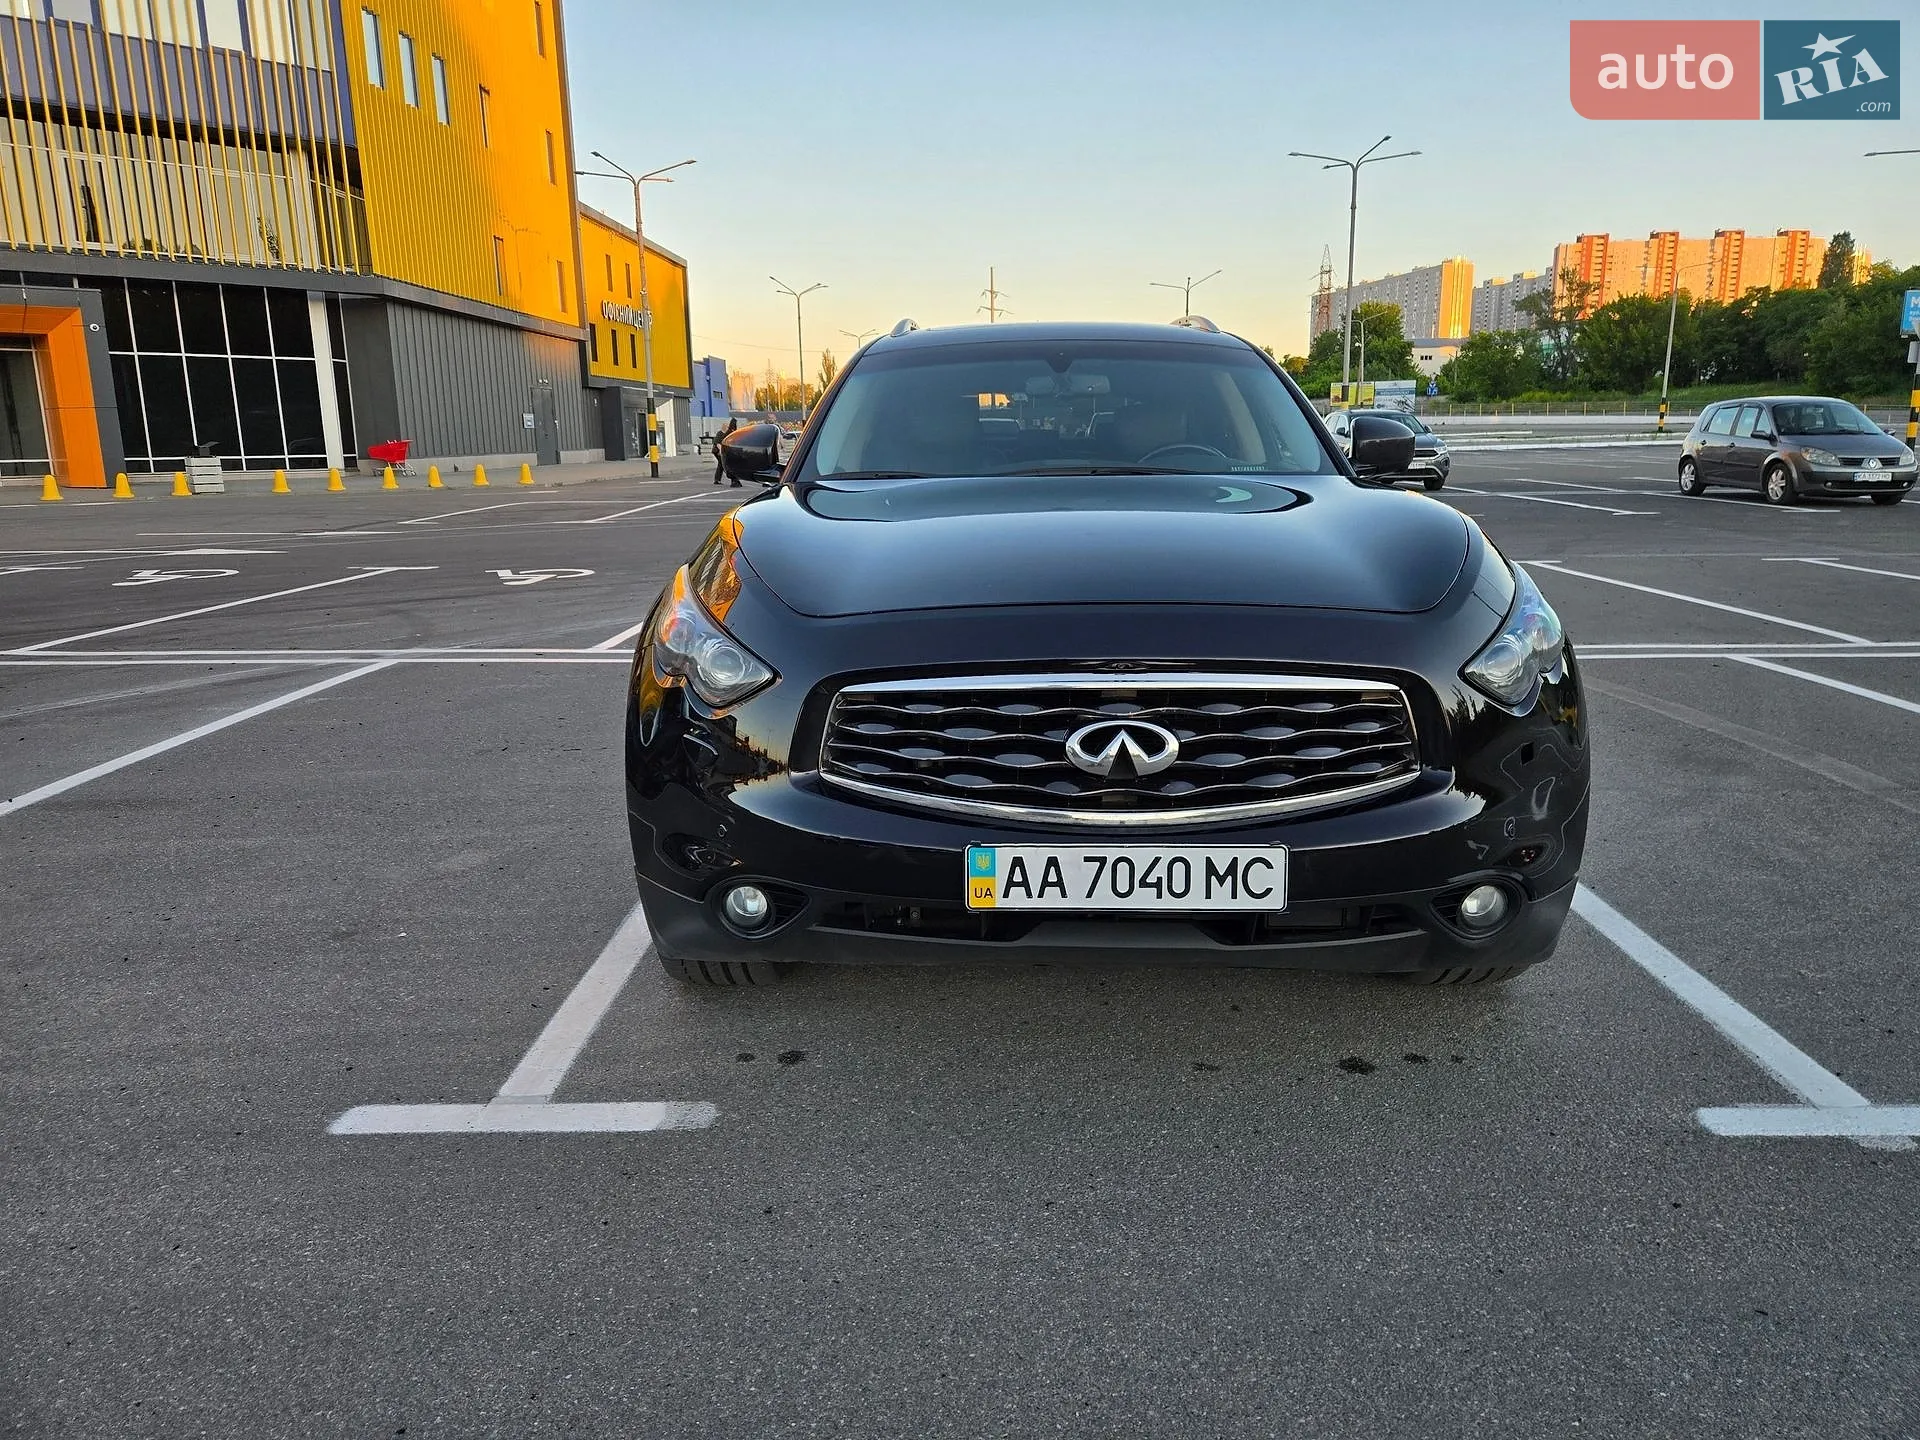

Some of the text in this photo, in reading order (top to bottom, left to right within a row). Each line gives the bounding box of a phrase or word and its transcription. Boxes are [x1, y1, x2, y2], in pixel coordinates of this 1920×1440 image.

[1002, 855, 1275, 900] AA 7040 MC
[974, 887, 994, 899] UA
